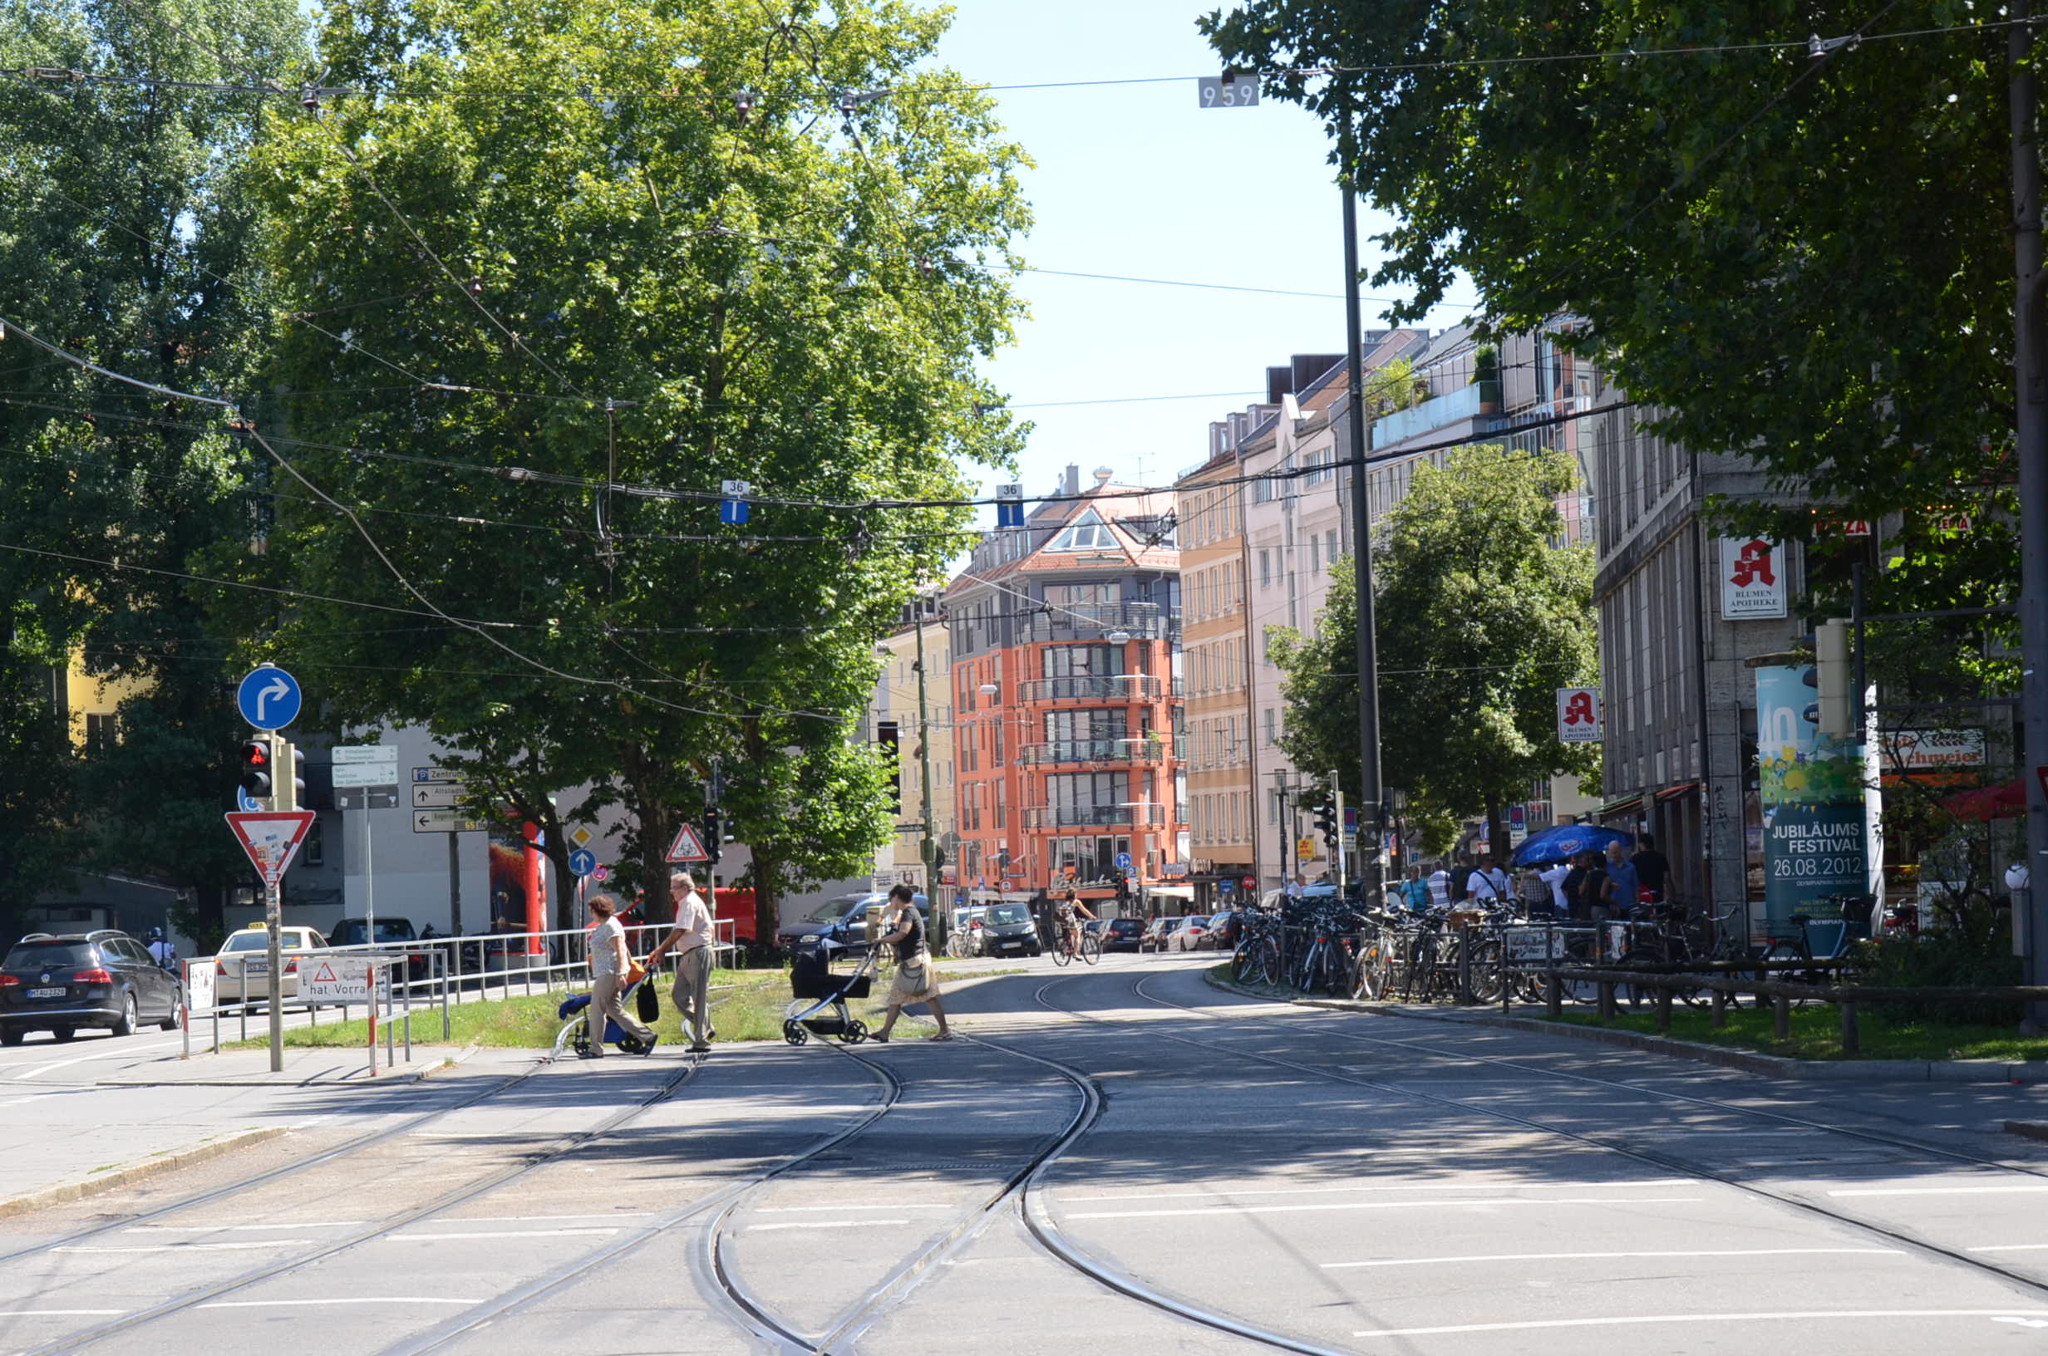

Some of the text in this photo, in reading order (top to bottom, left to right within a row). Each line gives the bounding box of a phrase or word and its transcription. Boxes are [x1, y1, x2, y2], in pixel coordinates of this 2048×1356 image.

[1203, 85, 1253, 107] 959
[730, 481, 744, 492] 36
[1003, 484, 1017, 495] 36
[1735, 590, 1773, 599] BLUMEN
[1730, 598, 1779, 608] APOTHEKE
[431, 770, 465, 779] Zentrum
[1772, 821, 1860, 839] JUBILÄUMS
[1788, 838, 1861, 854] FESTIVAL
[1774, 857, 1863, 877] 26.08.2012
[310, 984, 328, 995] hat
